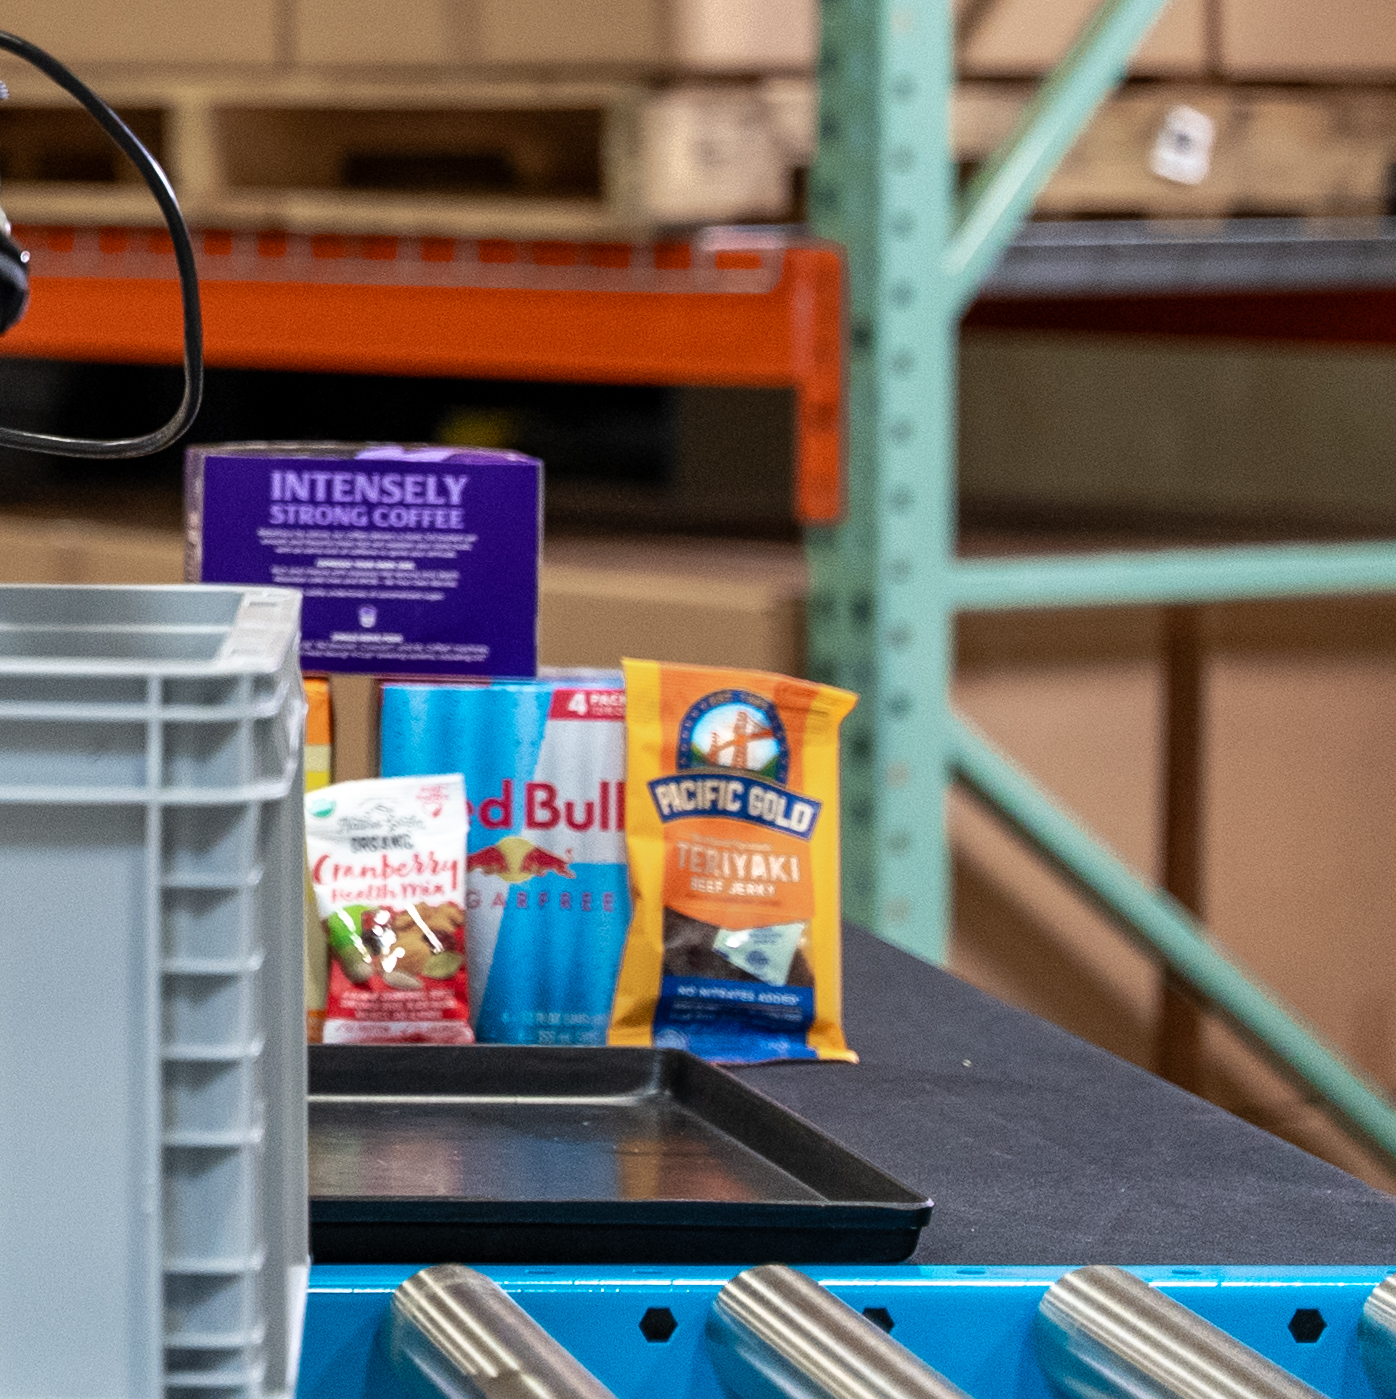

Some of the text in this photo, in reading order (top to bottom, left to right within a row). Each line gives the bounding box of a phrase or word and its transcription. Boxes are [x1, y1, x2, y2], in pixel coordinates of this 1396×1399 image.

[270, 470, 468, 505] INTENSELY
[269, 505, 465, 529] STRONG COFFEE
[567, 692, 589, 716] 4
[525, 781, 626, 832] Bull
[655, 778, 815, 833] PACIFIC GOLD
[313, 851, 458, 891] Cranberry
[676, 839, 801, 883] TERIYAKI
[466, 889, 615, 913] GARFREE
[689, 875, 724, 895] BEEF
